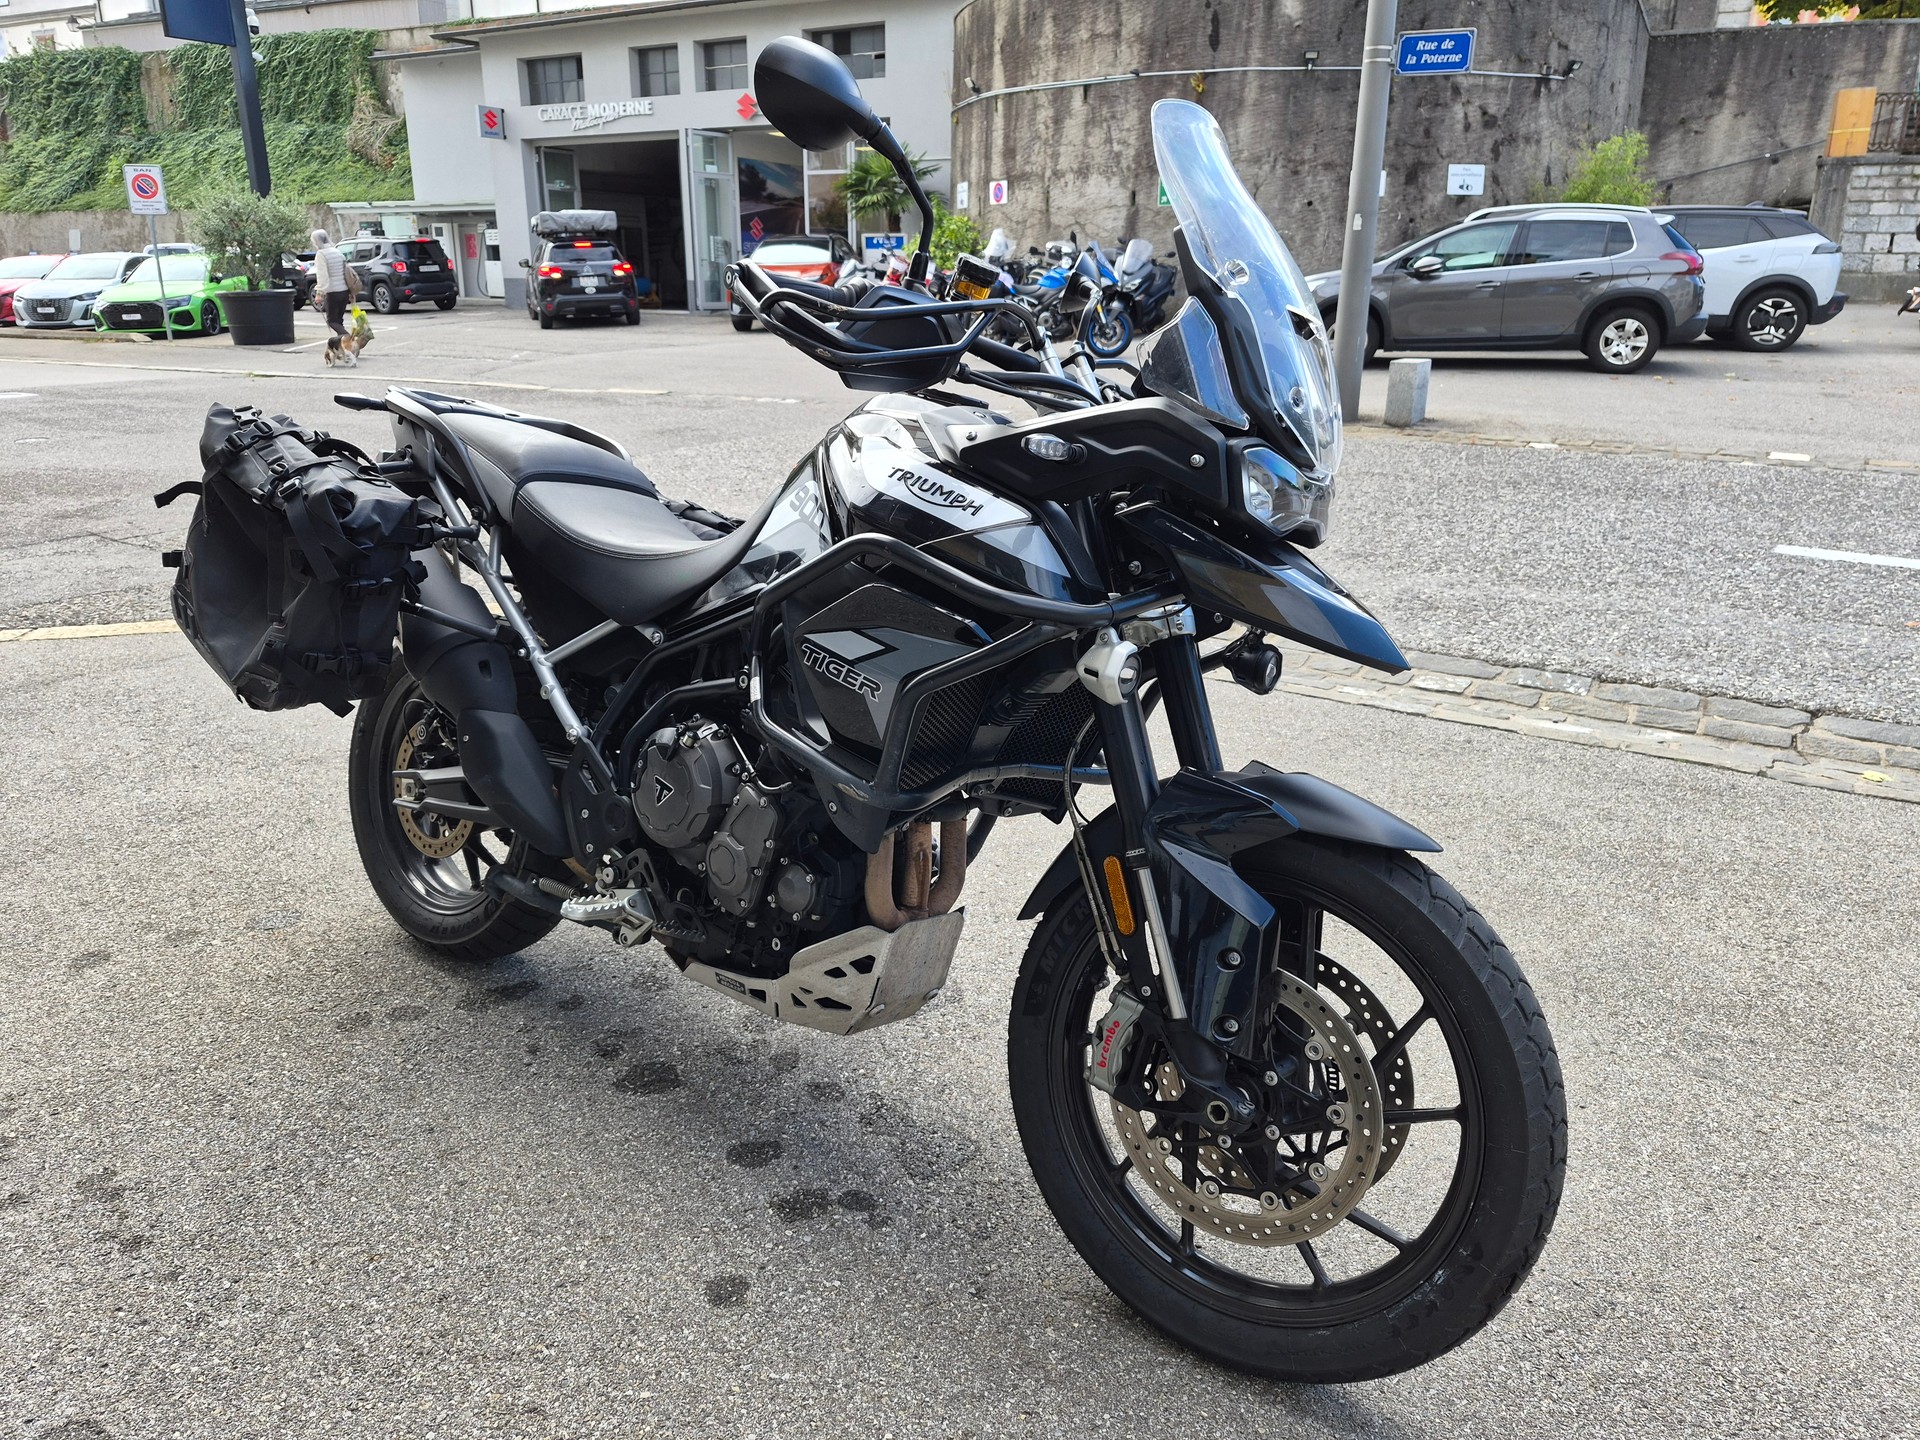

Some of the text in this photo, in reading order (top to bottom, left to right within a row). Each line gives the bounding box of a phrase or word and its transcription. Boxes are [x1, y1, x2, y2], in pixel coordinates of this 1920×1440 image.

[1405, 53, 1463, 65] la Poterne
[1416, 38, 1455, 51] Rue de
[538, 100, 653, 121] GARAGE MODERNE
[888, 467, 984, 516] TRIUMPH
[801, 643, 883, 703] TIGER
[1096, 1020, 1121, 1069] brembo
